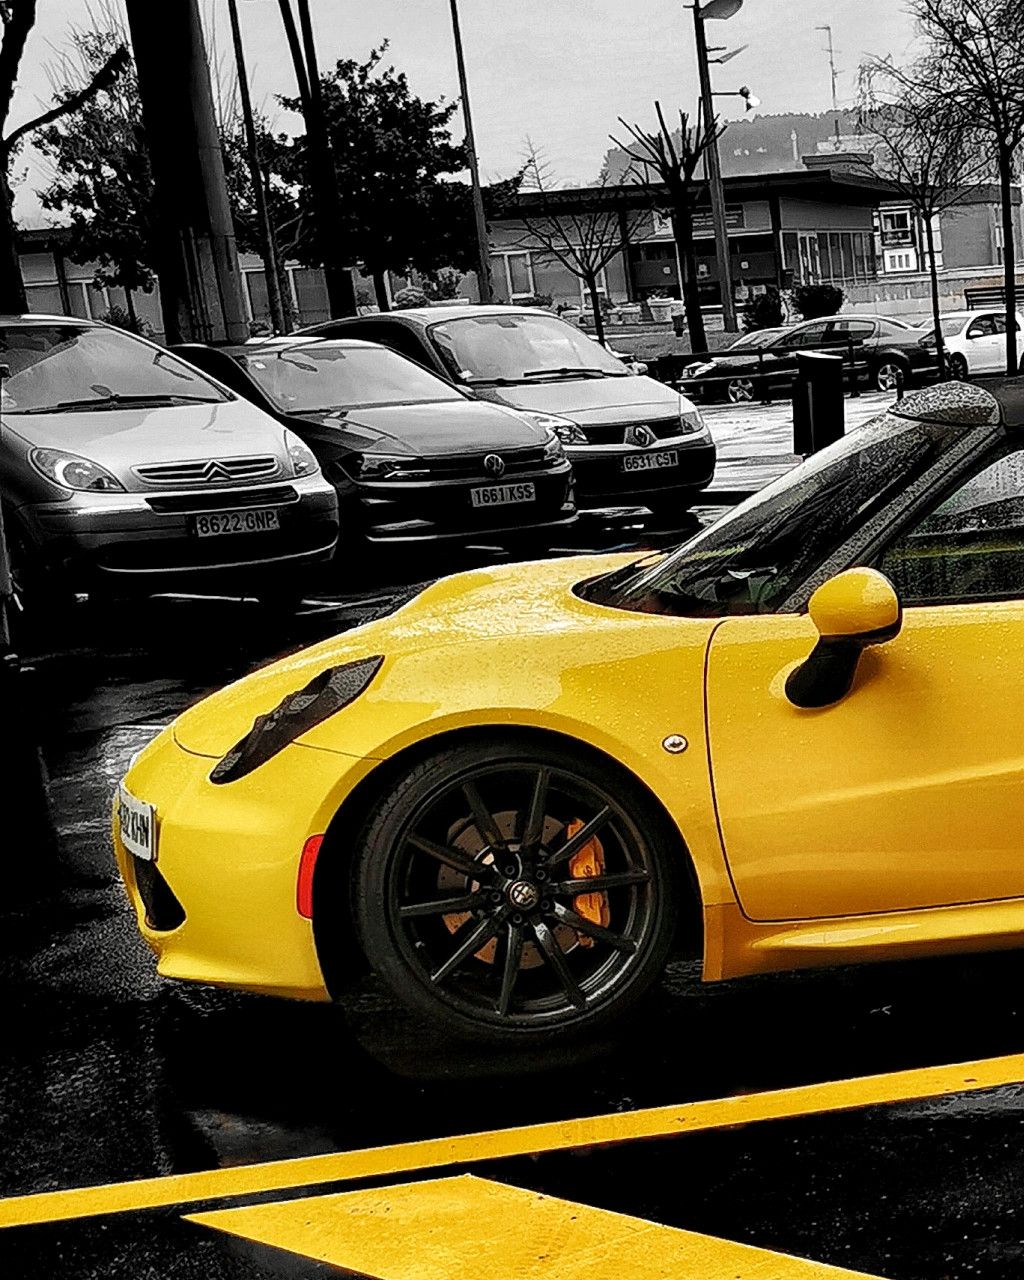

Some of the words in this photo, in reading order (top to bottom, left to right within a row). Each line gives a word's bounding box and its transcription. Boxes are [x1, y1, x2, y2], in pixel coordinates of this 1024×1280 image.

[475, 487, 504, 504] 1661
[509, 484, 532, 501] KSS
[199, 513, 242, 535] 8622
[245, 510, 275, 531] GNP
